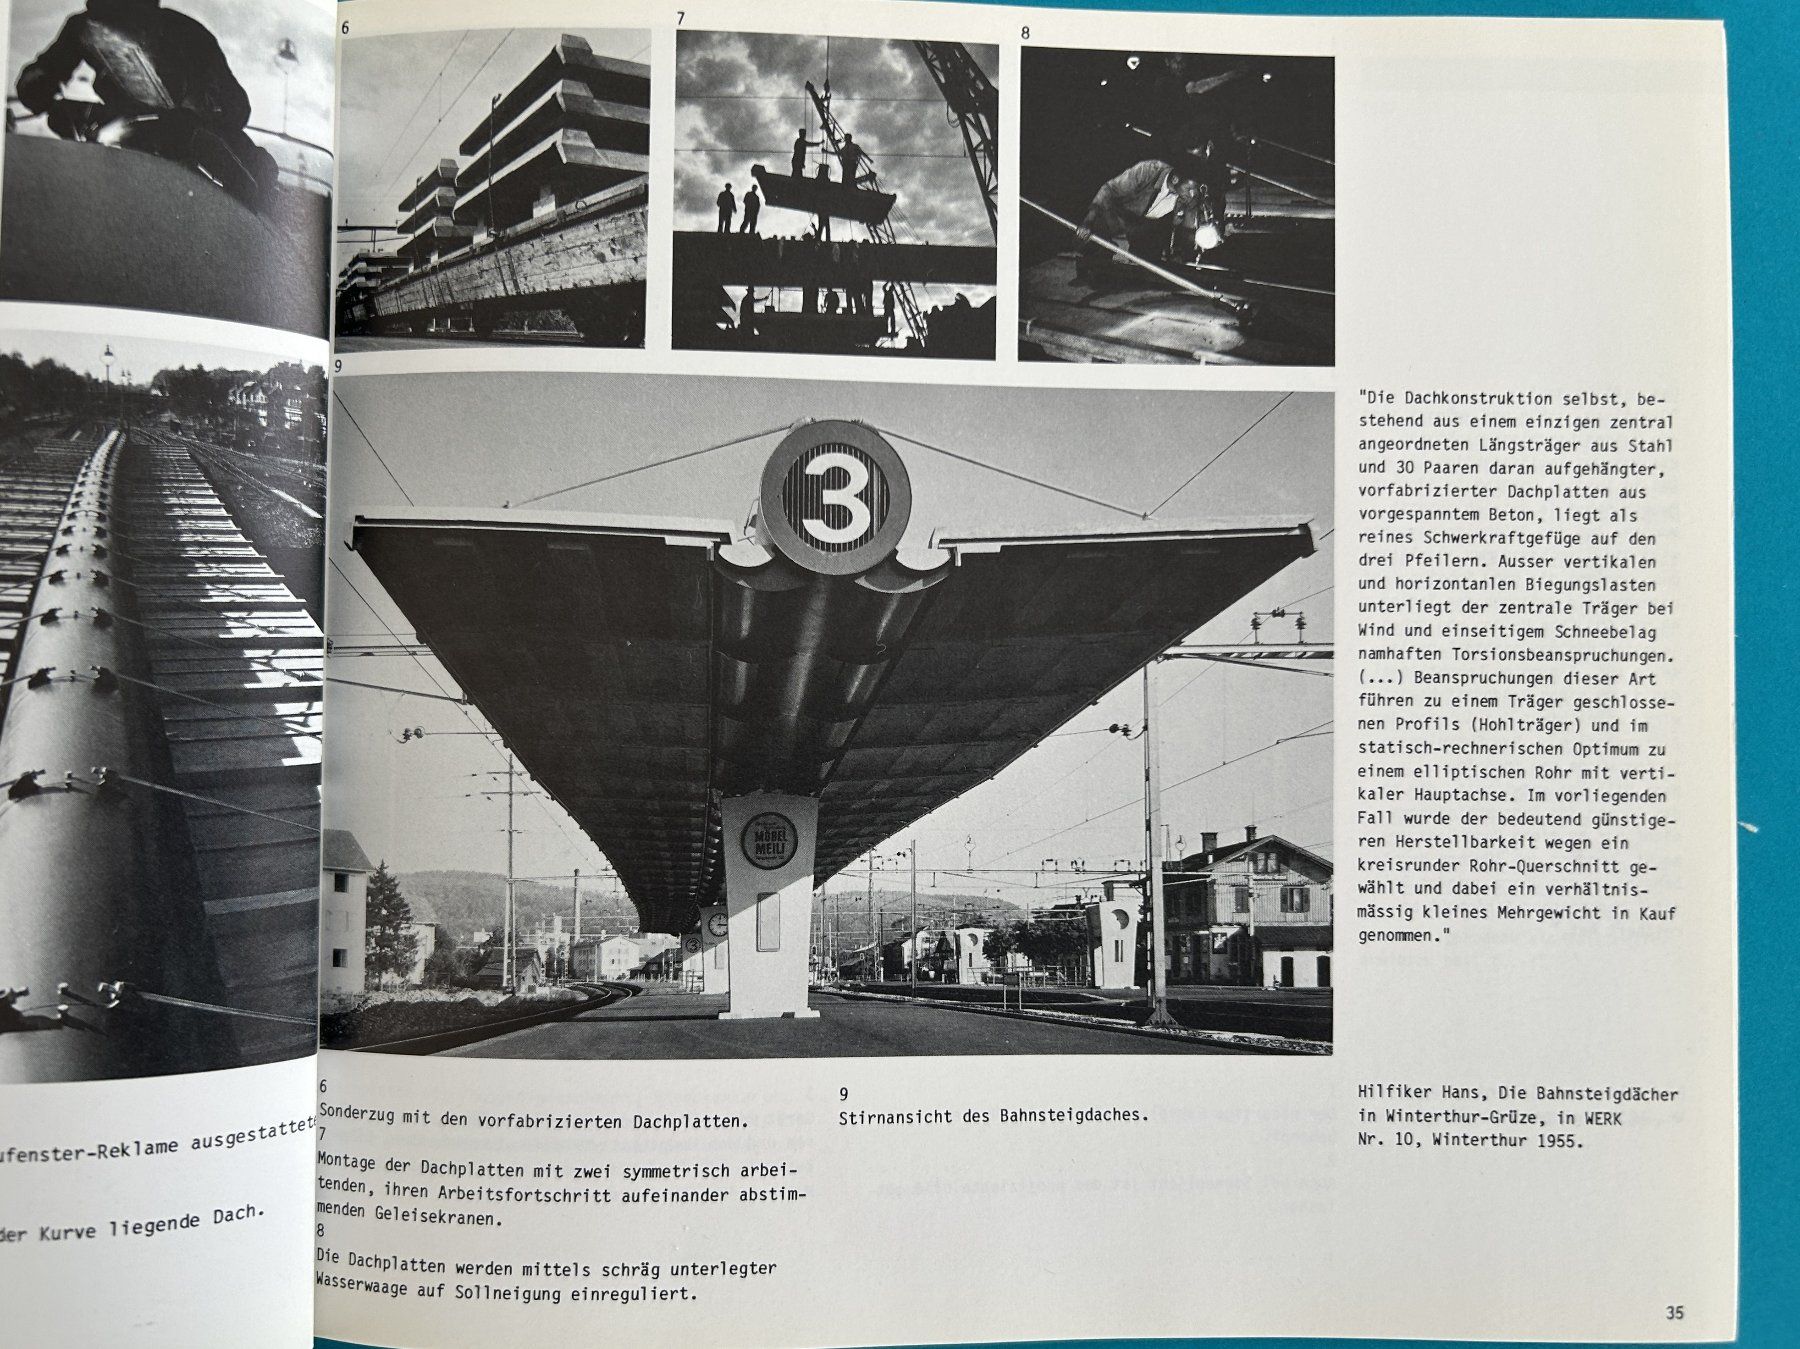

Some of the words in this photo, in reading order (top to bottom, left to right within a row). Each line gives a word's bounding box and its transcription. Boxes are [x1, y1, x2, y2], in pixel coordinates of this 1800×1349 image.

[342, 20, 349, 34] 6
[677, 11, 685, 25] 7
[1021, 26, 1030, 39] 8
[335, 359, 342, 373] 9
[1360, 389, 1394, 404] "Die
[1406, 391, 1552, 405] Dachkonstruktion
[1563, 392, 1626, 408] selbst,
[1638, 392, 1665, 406] be-
[1360, 414, 1423, 427] stehend
[1433, 417, 1459, 427] aus
[1470, 414, 1516, 428] einem
[1526, 415, 1600, 432] einzigen
[1610, 416, 1672, 429] zentral
[1359, 437, 1468, 453] angeordneten
[1480, 438, 1581, 455] Längsträger
[1591, 442, 1617, 452] aus
[1628, 439, 1672, 452] Stahl
[1359, 460, 1385, 473] und
[1397, 460, 1414, 474] 30
[1424, 461, 1478, 474] Paaren
[1489, 461, 1534, 475] daran
[1545, 461, 1664, 479] aufgehängter,
[802, 452, 871, 544] 3
[1359, 483, 1497, 497] vorfabrizierter
[1508, 484, 1609, 501] Dachplatten
[1619, 488, 1646, 499] aus
[1359, 508, 1480, 523] vorgespanntem
[1489, 508, 1542, 524] Beton,
[1554, 508, 1600, 525] liegt
[1610, 508, 1637, 522] als
[1359, 530, 1413, 543] reines
[1424, 531, 1580, 548] Schwerkraftgefüge
[1591, 532, 1618, 545] auf
[1629, 532, 1656, 545] den
[1359, 553, 1392, 566] drei
[1406, 553, 1486, 567] Pfeilern.
[1498, 555, 1554, 568] Ausser
[1564, 555, 1656, 569] vertikalen
[1359, 576, 1386, 589] und
[1396, 576, 1516, 590] horizontanlen
[1526, 577, 1656, 594] Biegungslasten
[1359, 599, 1451, 616] unterliegt
[1462, 600, 1488, 613] der
[1499, 601, 1572, 614] zentrale
[1582, 601, 1638, 618] Träger
[1648, 602, 1673, 615] bei
[1358, 623, 1394, 636] Wind
[1405, 624, 1432, 637] und
[1442, 624, 1544, 641] einseitigem
[1555, 625, 1656, 642] Schneebelag
[1359, 646, 1441, 660] namhaften
[1452, 647, 1673, 665] Torsionsbeanspruchungen.
[1360, 669, 1402, 685] (...)
[1414, 671, 1553, 688] Beanspruchungen
[1564, 671, 1619, 685] dieser
[1629, 672, 1656, 686] Art
[1359, 693, 1413, 707] führen
[1424, 697, 1441, 707] zu
[1452, 694, 1498, 708] einem
[1508, 694, 1564, 711] Träger
[1574, 695, 1675, 711] geschlosse-
[1358, 720, 1385, 730] nen
[1396, 717, 1459, 731] Profils
[1472, 717, 1580, 735] (Hohlträger)
[1592, 719, 1619, 732] und
[1630, 719, 1648, 732] im
[1359, 740, 1563, 755] statisch-rechnerischen
[1573, 742, 1640, 758] Optimum
[1648, 746, 1666, 756] zu
[1358, 764, 1404, 777] einem
[1414, 764, 1525, 781] elliptischen
[1535, 766, 1572, 779] Rohr
[1582, 766, 1609, 779] mit
[1620, 767, 1676, 780] verti-
[1358, 786, 1404, 800] kaler
[1415, 788, 1514, 804] Hauptachse.
[1528, 789, 1545, 802] Im
[1555, 788, 1666, 806] vorliegenden
[1358, 811, 1392, 824] Fall
[1404, 811, 1450, 825] wurde
[1461, 812, 1488, 825] der
[1498, 812, 1582, 826] bedeutend
[1592, 813, 1676, 830] günstige-
[1359, 837, 1385, 847] ren
[1396, 834, 1535, 849] Herstellbarkeit
[1545, 839, 1591, 852] wegen
[1601, 836, 1629, 849] ein
[1358, 858, 1460, 872] kreisrunder
[1470, 859, 1619, 875] Rohr-Querschnitt
[1630, 863, 1657, 877] ge-
[1358, 880, 1404, 894] wählt
[1415, 881, 1442, 894] und
[1452, 881, 1496, 895] dabei
[1508, 882, 1535, 895] ein
[1546, 882, 1648, 896] verhältnis-
[1357, 904, 1413, 921] mässig
[1423, 905, 1487, 919] kleines
[1498, 906, 1601, 922] Mehrgewicht
[1612, 906, 1629, 919] in
[1640, 907, 1677, 920] Kauf
[1359, 928, 1449, 944] genommen."
[320, 1079, 327, 1093] 6
[840, 1087, 848, 1101] 9
[1359, 1084, 1432, 1098] Hilfiker
[1442, 1085, 1487, 1101] Hans,
[1499, 1085, 1527, 1099] Die
[1537, 1086, 1679, 1104] Bahnsteigdächer
[320, 1102, 394, 1125] Sonderzug
[403, 1109, 430, 1124] mit
[441, 1111, 467, 1125] den
[479, 1113, 621, 1129] vorfabrizierten
[634, 1114, 747, 1131] Dachplatten.
[839, 1109, 952, 1125] Stirnansicht
[963, 1109, 989, 1122] des
[1001, 1107, 1147, 1124] Bahnsteigdaches.
[1359, 1108, 1376, 1122] in
[1386, 1109, 1545, 1127] Winterthur-Grüze,
[1557, 1111, 1575, 1124] in
[1585, 1112, 1622, 1126] WERK
[319, 1127, 326, 1140] 7
[1359, 1132, 1383, 1145] Nr.
[1396, 1132, 1421, 1148] 10,
[1433, 1132, 1527, 1147] Winterthur
[1538, 1134, 1583, 1148] 1955.
[318, 1151, 375, 1172] Montage
[385, 1157, 410, 1172] der
[421, 1160, 523, 1178] Dachplatten
[534, 1164, 563, 1178] mit
[574, 1164, 610, 1178] zwei
[624, 1163, 729, 1181] symmetrisch
[741, 1162, 797, 1177] arbei-
[319, 1176, 373, 1197] tenden,
[385, 1181, 428, 1197] ihren
[438, 1185, 611, 1203] Arbeitsfortschritt
[622, 1188, 729, 1202] aufeinander
[740, 1186, 806, 1201] abstim-
[40, 1226, 96, 1241] Kurve
[110, 1213, 200, 1237] liegende
[214, 1204, 264, 1224] Dach.
[318, 1202, 364, 1217] menden
[376, 1206, 501, 1226] Geleisekranen.
[317, 1223, 324, 1237] 8
[317, 1247, 339, 1263] Die
[349, 1252, 445, 1273] Dachplatten
[456, 1261, 512, 1275] werden
[523, 1262, 590, 1277] mittels
[603, 1262, 660, 1279] schräg
[671, 1261, 777, 1278] unterlegter
[317, 1271, 407, 1298] Wasserwaage
[418, 1283, 445, 1297] auf
[455, 1285, 561, 1304] Sollneigung
[572, 1286, 696, 1304] einreguliert.
[1666, 1305, 1684, 1320] 35
